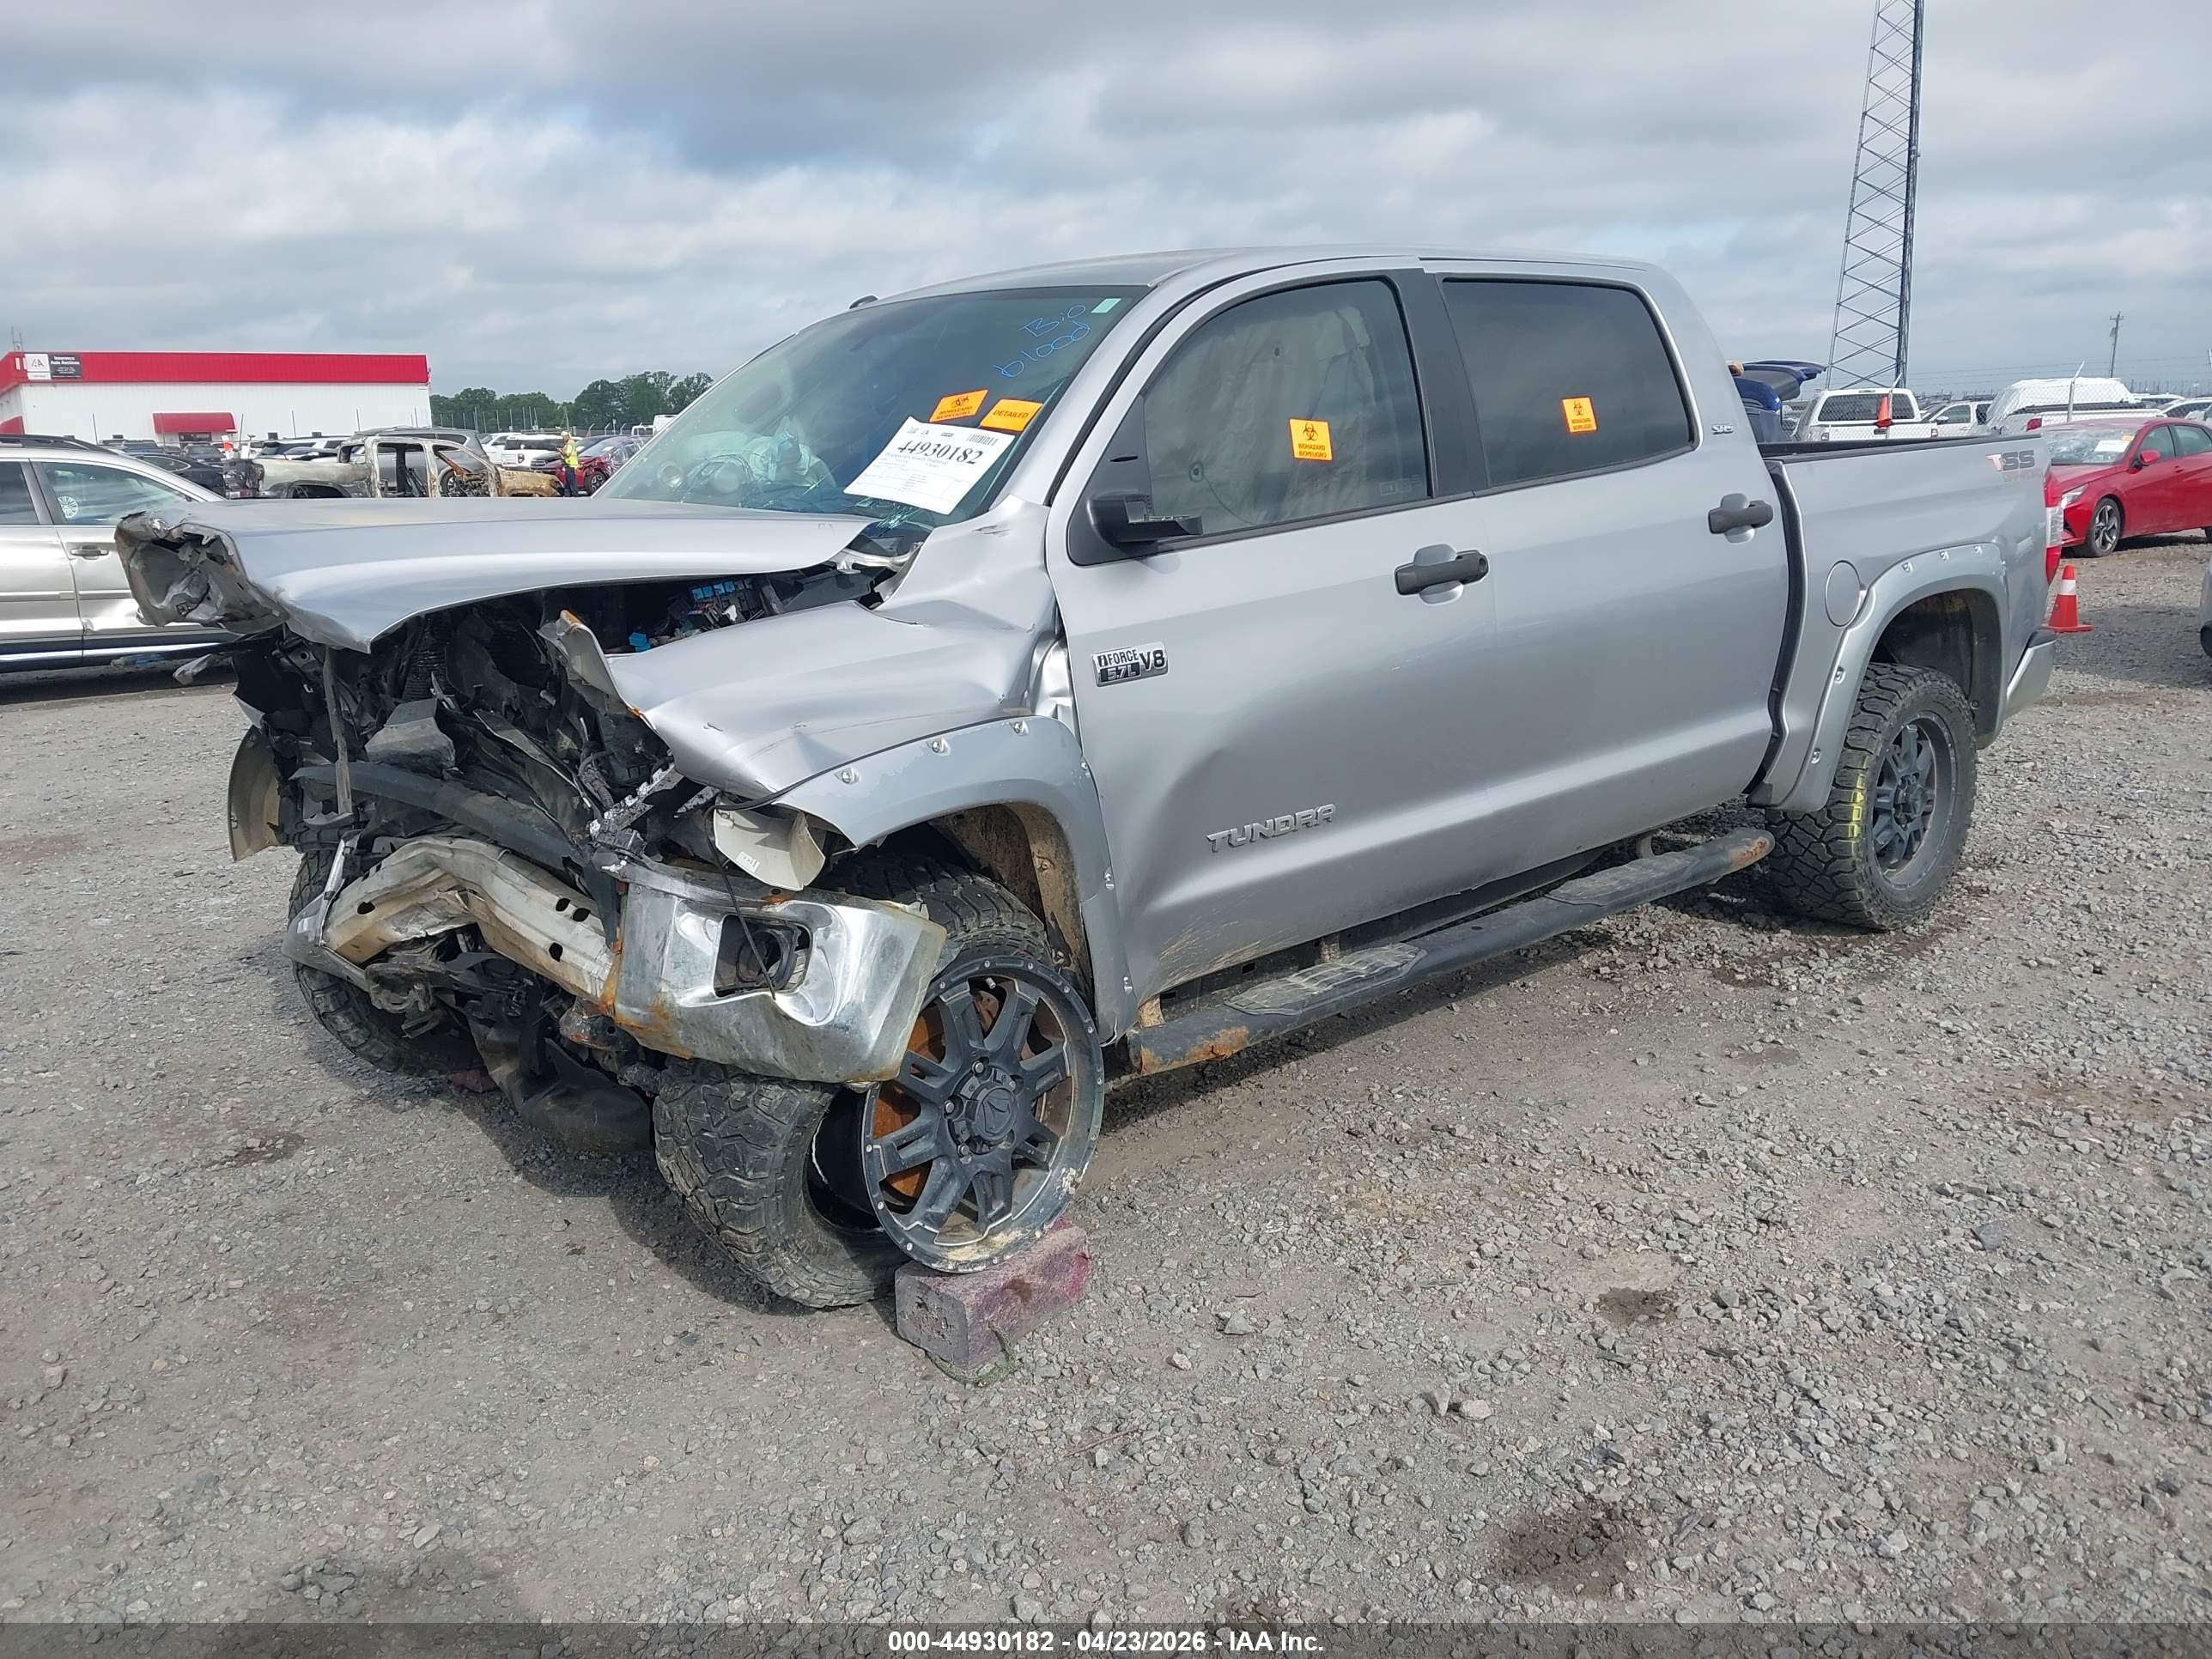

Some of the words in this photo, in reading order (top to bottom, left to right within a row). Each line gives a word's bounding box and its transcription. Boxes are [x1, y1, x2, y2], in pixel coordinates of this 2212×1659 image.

[993, 409, 1029, 418] DETAILED
[897, 440, 984, 465] 44930182
[1139, 649, 1165, 670] V8
[1107, 663, 1137, 681] 5.7L
[1206, 803, 1336, 853] TUNDRA
